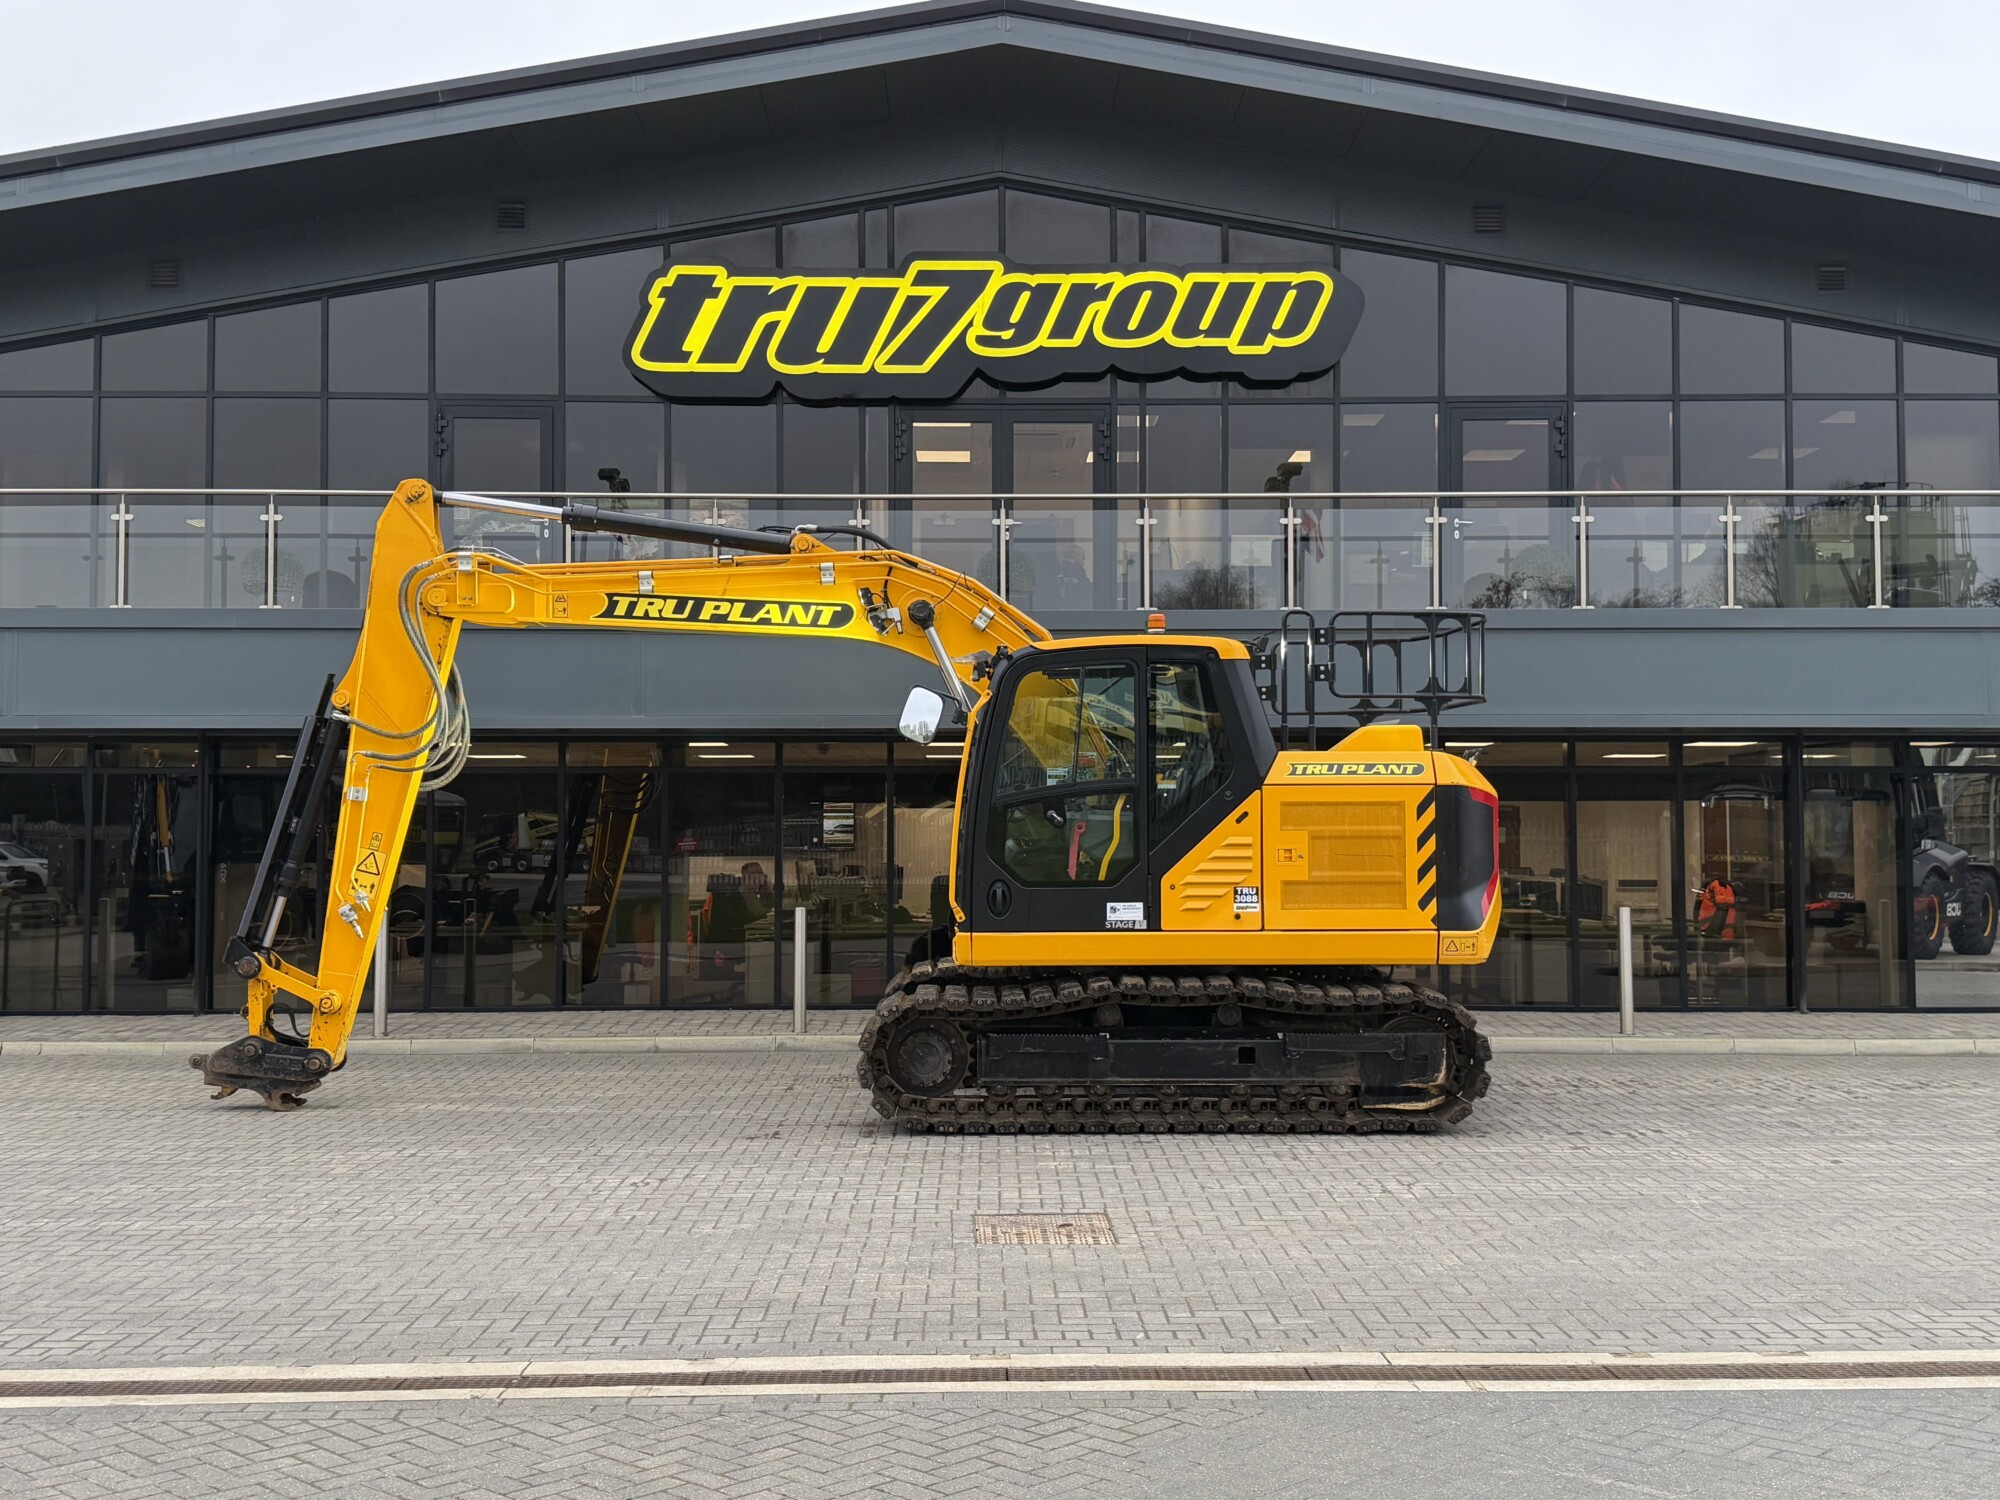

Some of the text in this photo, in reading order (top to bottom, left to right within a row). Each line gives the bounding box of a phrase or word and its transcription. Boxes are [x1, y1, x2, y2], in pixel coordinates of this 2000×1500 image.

[631, 261, 1333, 374] tru7group
[612, 596, 842, 625] TRU PLANT
[1294, 764, 1418, 774] TRU PLANT
[1105, 920, 1134, 929] STAGE
